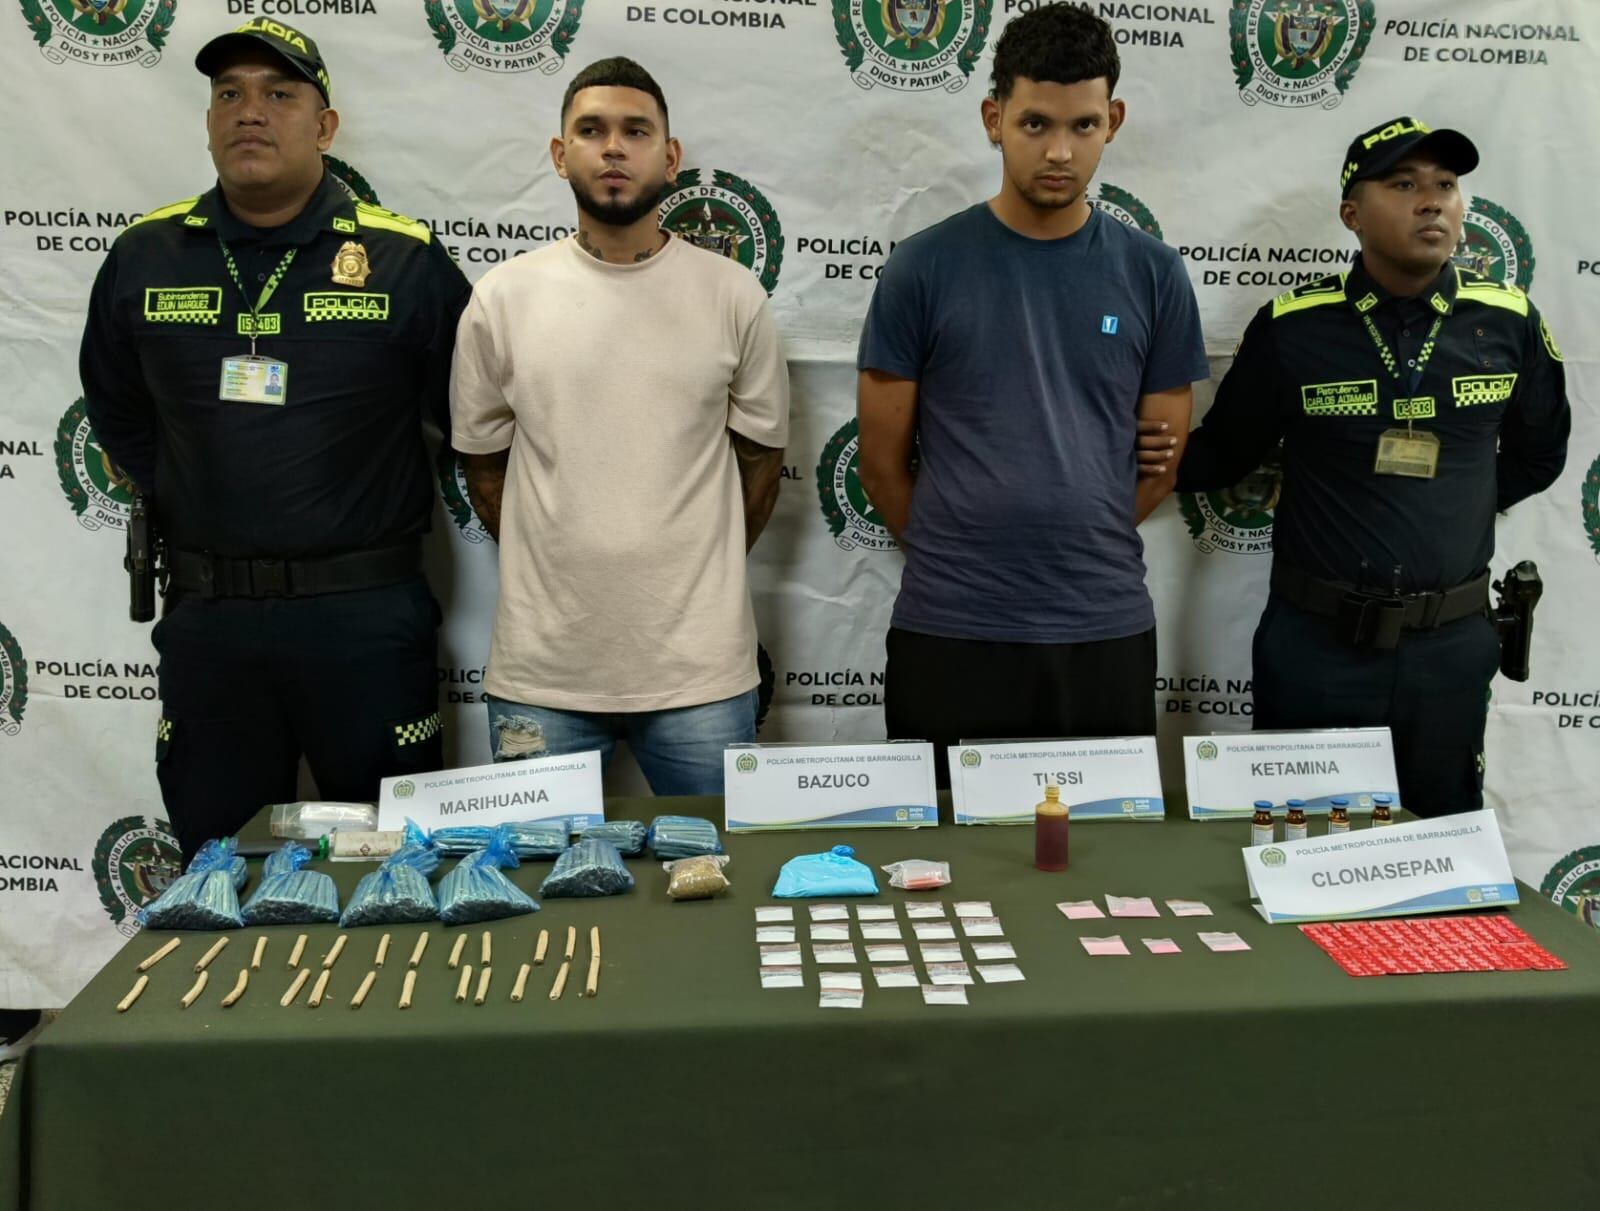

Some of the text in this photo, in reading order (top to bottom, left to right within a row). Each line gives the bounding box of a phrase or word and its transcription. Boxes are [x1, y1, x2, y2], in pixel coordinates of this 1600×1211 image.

[228, 0, 377, 15] DE COLOMBIA
[1100, 2, 1215, 24] NACIONAL
[45, 6, 154, 47] POLICIA NACIONAL
[626, 6, 786, 29] DE COLOMBIA
[1346, 0, 1358, 42] OMBIA
[450, 13, 559, 54] POLICIA NACIONAL
[1114, 28, 1185, 48] OMBIA
[1384, 18, 1581, 42] POLICÍA NACIONAL
[59, 41, 89, 60] DIOS
[103, 45, 144, 63] PATRIA
[463, 48, 494, 68] DIOS
[505, 51, 546, 70] PATRIA
[858, 30, 967, 71] POLICIA NACIONAL
[1403, 46, 1549, 66] DE COLOMBIA
[870, 65, 898, 85] DIOS
[910, 70, 951, 88] PATRIA
[1250, 52, 1345, 89] POLICIA NACIONAL
[1256, 84, 1279, 102] DIOS
[1290, 88, 1329, 104] PATRIA
[4, 208, 91, 227] POLICÍA
[700, 187, 717, 198] DE
[729, 196, 765, 260] COLOMBIA
[36, 236, 64, 251] DE
[796, 236, 884, 256] POLICÍA
[1179, 243, 1262, 262] POLICÍA
[1483, 220, 1516, 280] COLOMBIA
[825, 264, 853, 279] DE
[1203, 270, 1231, 286] DE
[313, 296, 381, 311] POLICÍA
[242, 317, 277, 330] 15403
[1460, 378, 1510, 394] POLICÍA
[82, 479, 120, 512] POLICIA
[95, 510, 123, 527] DIOS
[842, 501, 876, 533] POLICIA
[1201, 504, 1235, 536] POLICIA
[851, 531, 877, 548] DIOS
[1210, 534, 1235, 550] DIOS
[35, 659, 118, 677] POLICÍA
[786, 668, 865, 686] POLICÍA
[64, 684, 156, 700] DE COLO
[1154, 674, 1220, 693] OLICÍA
[447, 691, 474, 704] DE
[811, 693, 837, 705] DE
[1532, 690, 1600, 708] POLICÍ
[1166, 699, 1254, 716] DE COLO
[1558, 714, 1584, 728] DE
[990, 747, 1144, 761] POLICÍA METROPOLITANA DE BARRANQUILLA
[1226, 741, 1382, 753] POLICÍA METROPOLITANA DE BARRANQUILLA
[766, 754, 922, 766] POLICÍA METROPOLITANA DE BARRANQUILLA
[1251, 760, 1340, 776] KETAMINA
[424, 762, 587, 789] POLICÍA METROPOLITANA DE BARRANQUILLA
[797, 773, 870, 789] BAZUCO
[439, 788, 550, 816] MARIHUANA
[1295, 824, 1482, 856] POLICÍA METROPOLITANA DE BARRANQUILLA
[0, 855, 84, 871] ACIONAL
[112, 830, 161, 881] REPUBLICA DE
[1311, 856, 1455, 888] CLONASEPAM
[0, 877, 59, 892] OMBIA
[1553, 863, 1592, 902] PUBLICA
